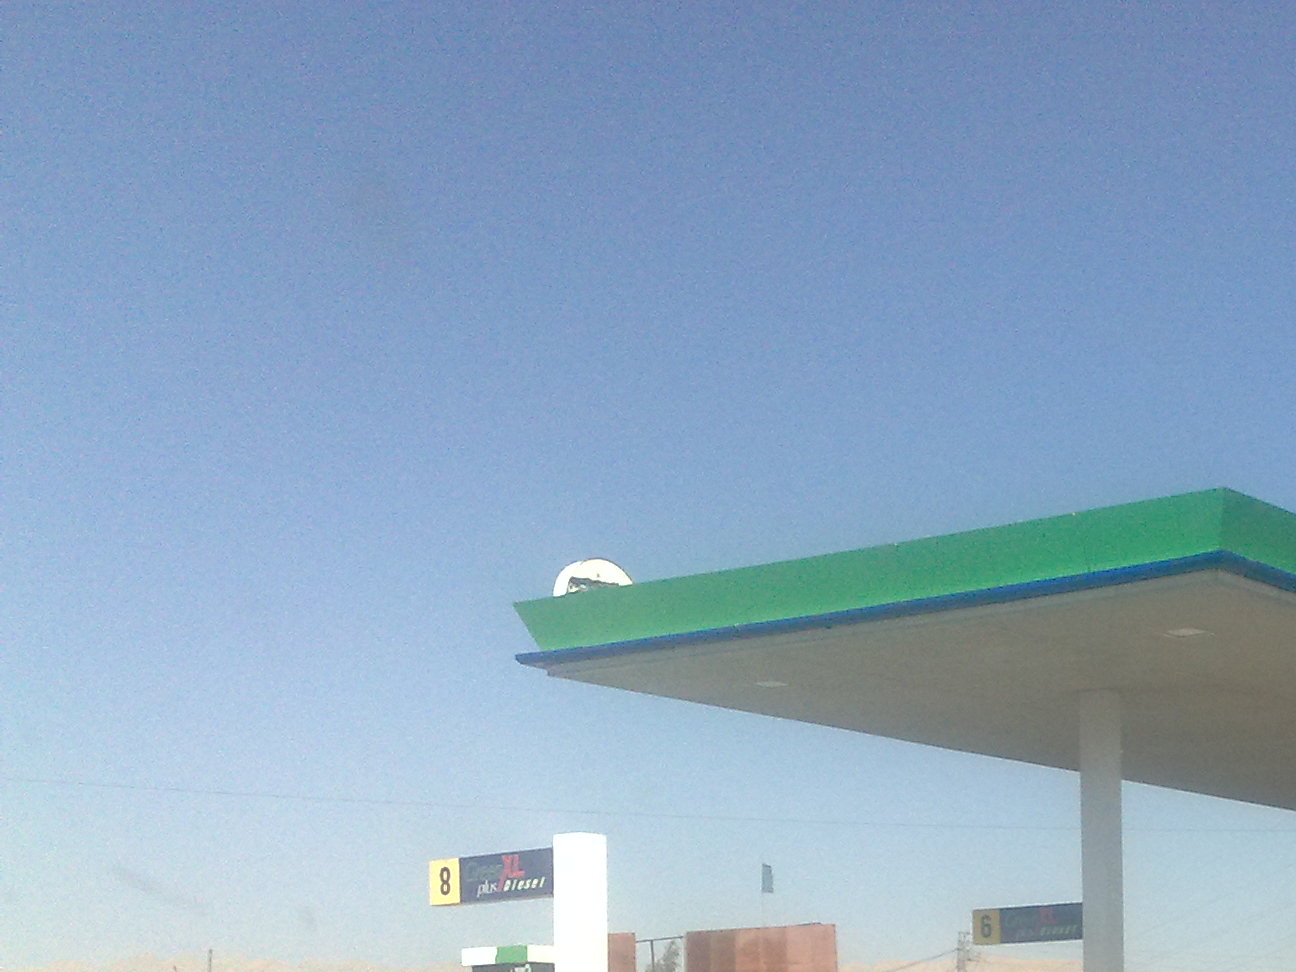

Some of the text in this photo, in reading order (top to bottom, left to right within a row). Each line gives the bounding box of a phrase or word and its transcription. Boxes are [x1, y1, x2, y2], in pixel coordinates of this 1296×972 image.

[440, 866, 451, 896] 8
[503, 877, 546, 892] Diesel
[981, 914, 992, 939] 6
